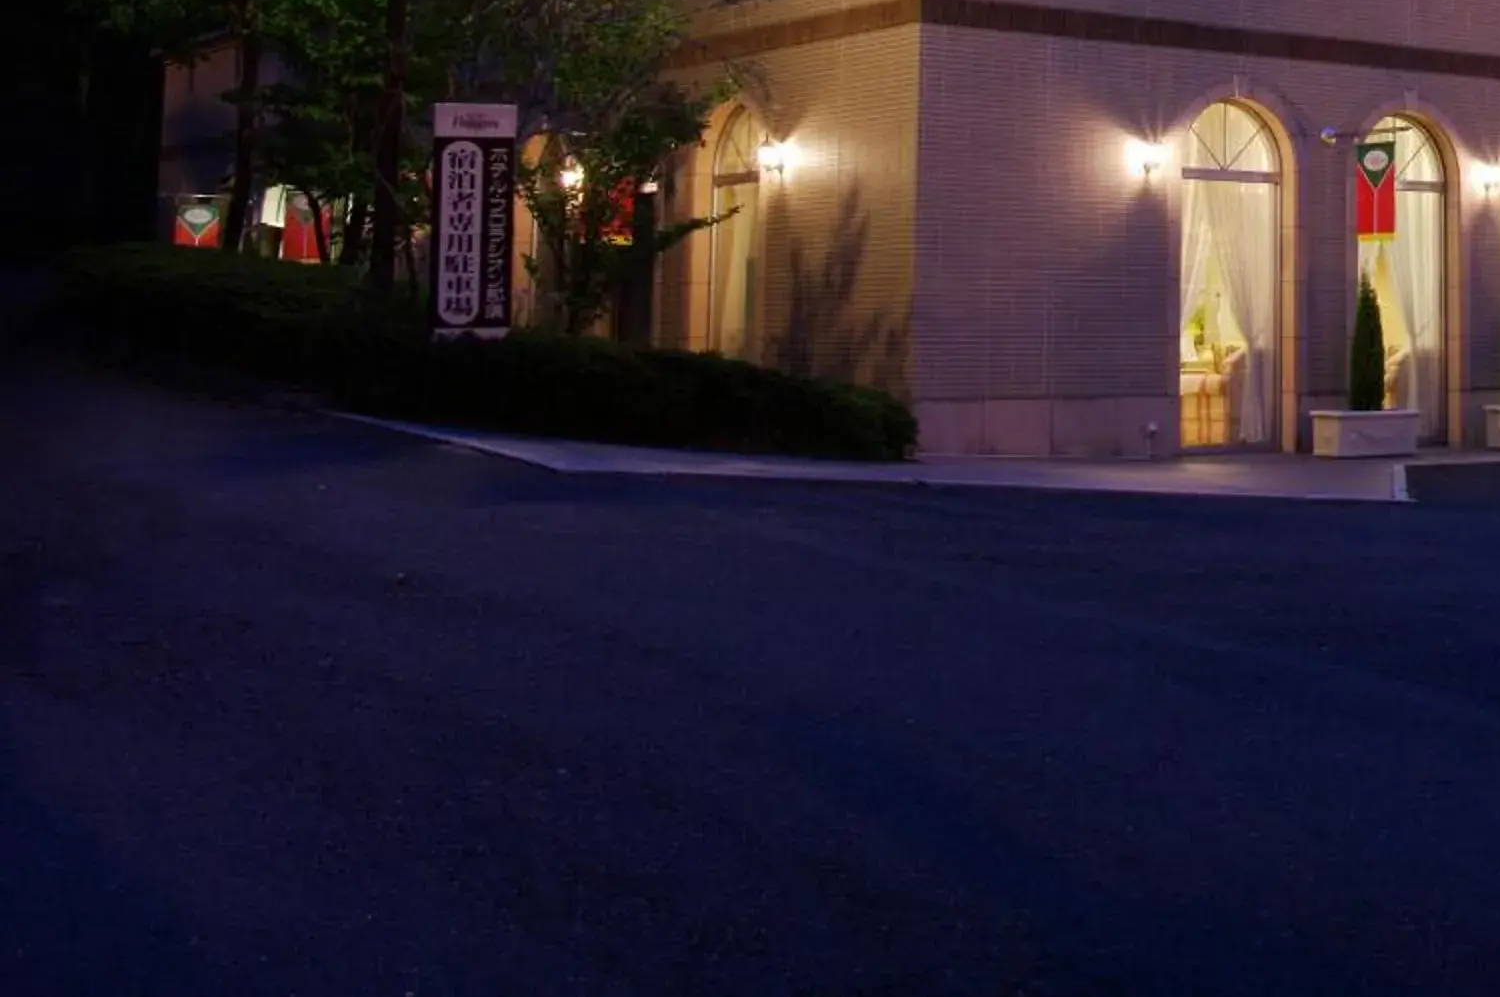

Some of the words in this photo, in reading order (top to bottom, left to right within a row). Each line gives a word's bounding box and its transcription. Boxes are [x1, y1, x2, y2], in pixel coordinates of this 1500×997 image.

[444, 149, 477, 316] 宿泊者専用駐車場
